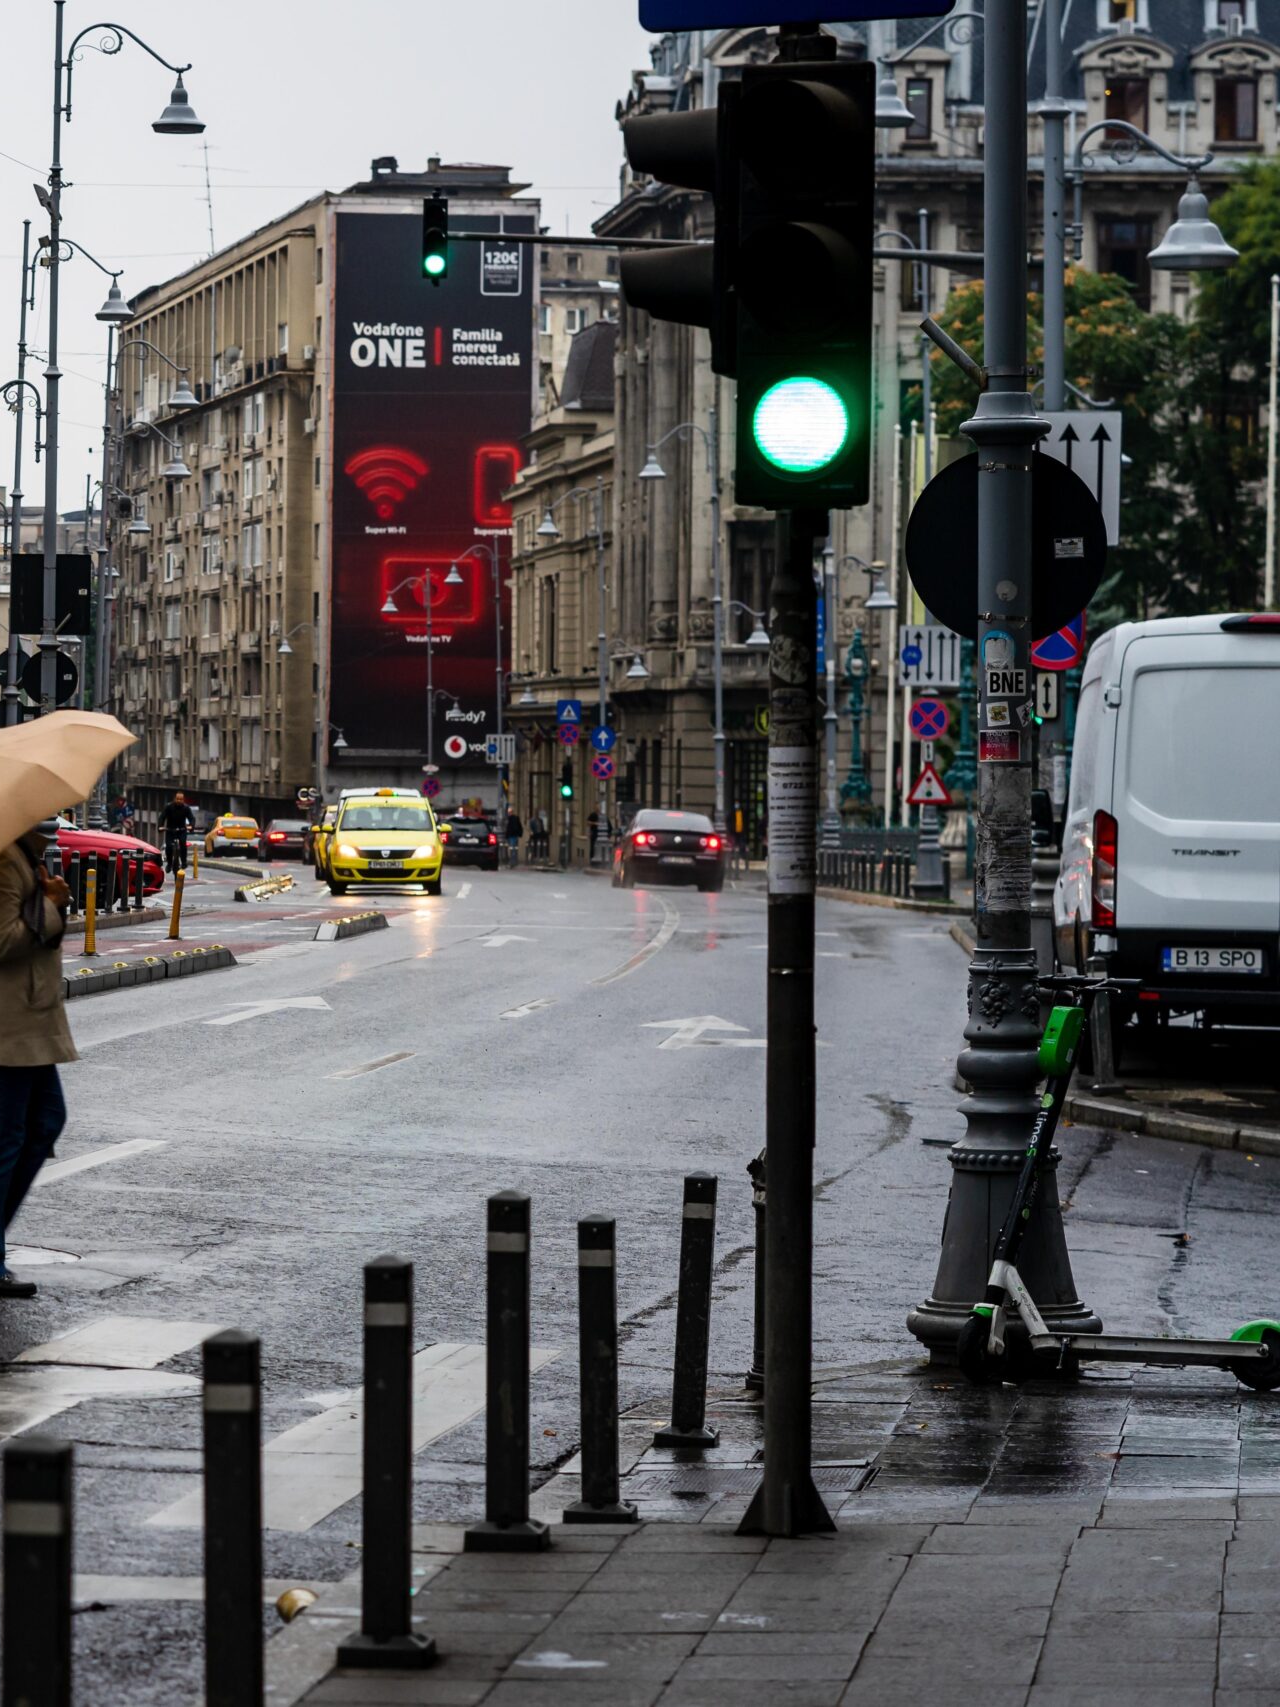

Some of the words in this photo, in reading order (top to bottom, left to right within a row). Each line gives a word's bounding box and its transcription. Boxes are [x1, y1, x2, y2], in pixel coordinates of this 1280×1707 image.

[352, 322, 424, 336] Vodafone
[452, 328, 503, 341] Familia
[350, 337, 426, 368] ONE
[452, 342, 497, 353] mereu
[452, 353, 521, 366] conectată
[365, 526, 387, 535] Super
[387, 526, 407, 535] Wi-Fi
[405, 635, 440, 643] Vodafne
[441, 635, 452, 643] TV
[989, 672, 1024, 693] BNE
[1171, 849, 1241, 857] TRANSIT
[1175, 949, 1188, 966] B
[1194, 950, 1210, 966] 13
[1219, 951, 1256, 967] SPO
